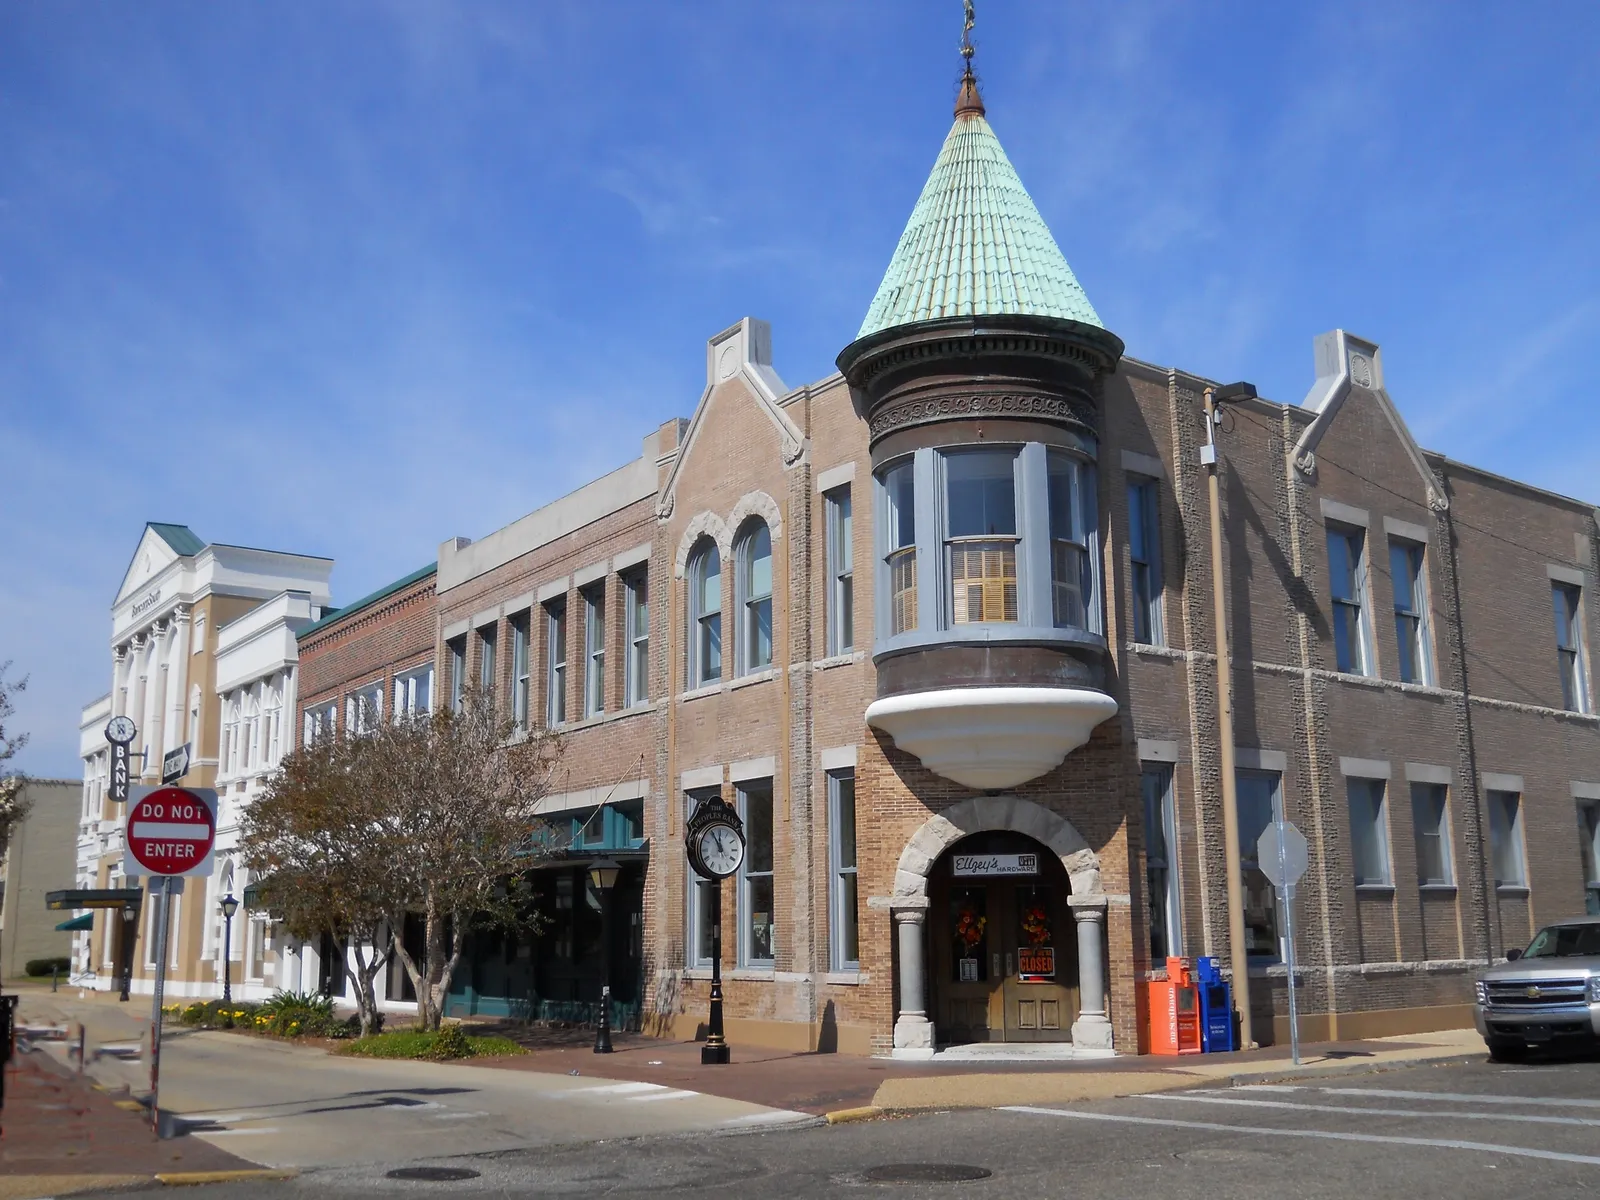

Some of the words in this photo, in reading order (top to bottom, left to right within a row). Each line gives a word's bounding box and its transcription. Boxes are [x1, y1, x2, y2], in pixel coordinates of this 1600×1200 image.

[115, 745, 126, 798] BANK
[142, 804, 164, 818] DO
[171, 805, 203, 819] NOT
[694, 812, 722, 827] PEOPLES
[722, 813, 740, 828] BANK
[145, 843, 195, 857] ENTER
[955, 857, 998, 873] Ellzey's
[1020, 956, 1053, 972] CLOSED
